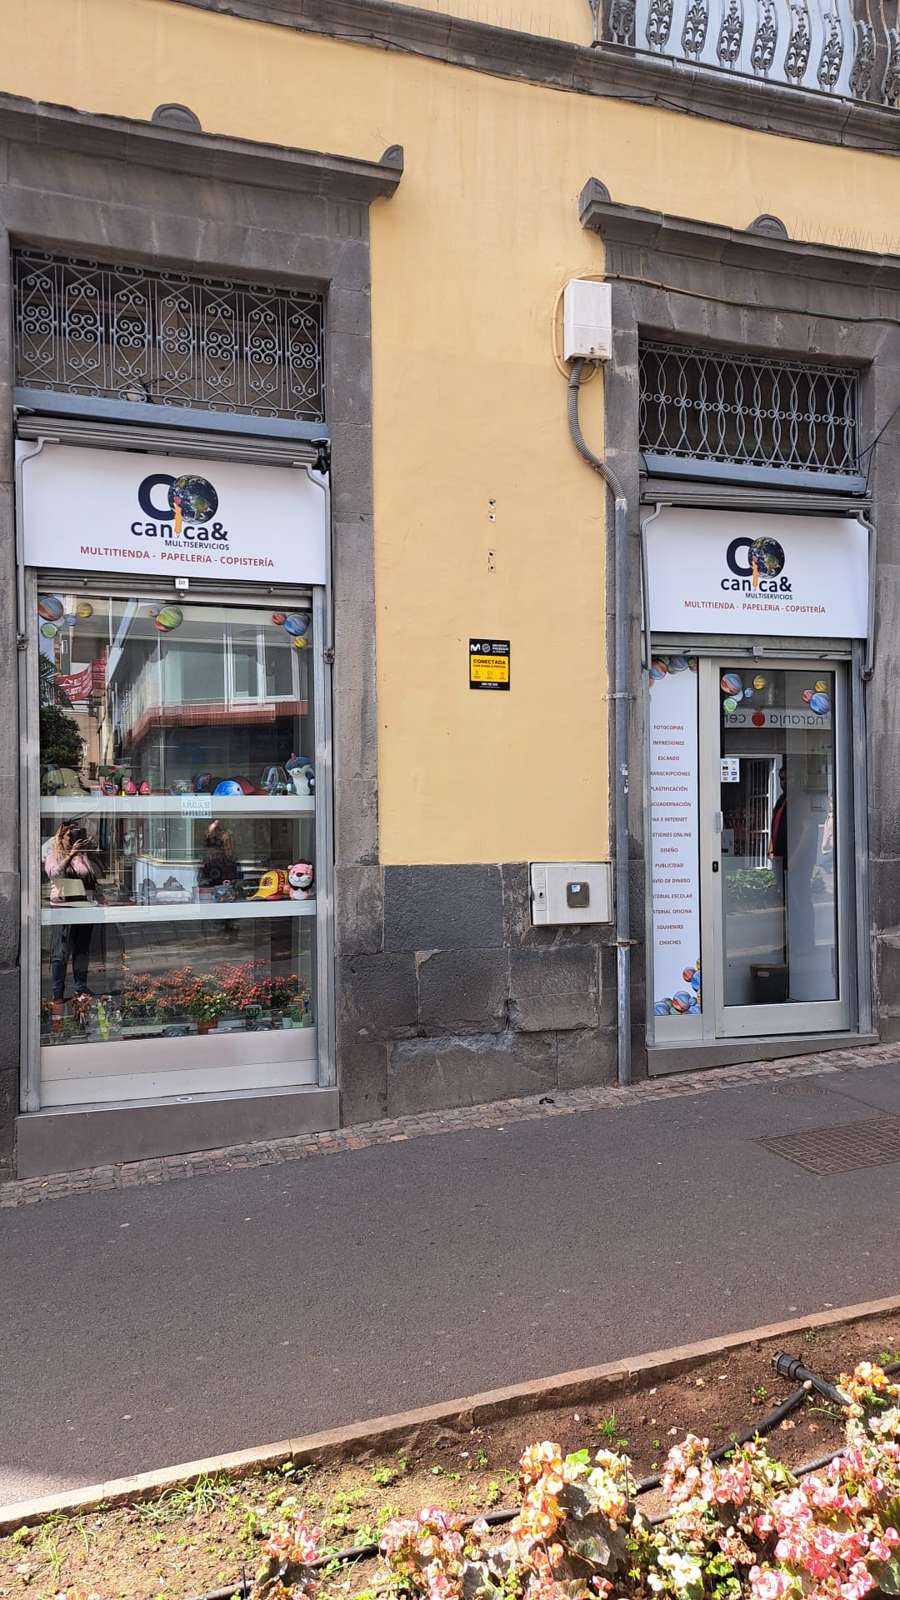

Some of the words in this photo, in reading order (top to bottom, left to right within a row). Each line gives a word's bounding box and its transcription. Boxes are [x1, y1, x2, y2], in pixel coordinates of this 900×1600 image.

[164, 539, 230, 551] MULTISERVICIOS
[80, 546, 150, 559] MULTITIENDA
[160, 552, 212, 563] PAPELERÍA
[219, 555, 274, 567] COPISTERÍA
[745, 592, 793, 600] MULTISERVICIOS
[684, 600, 735, 610] MULTITIENDA
[785, 605, 826, 614] COPISTERÍA
